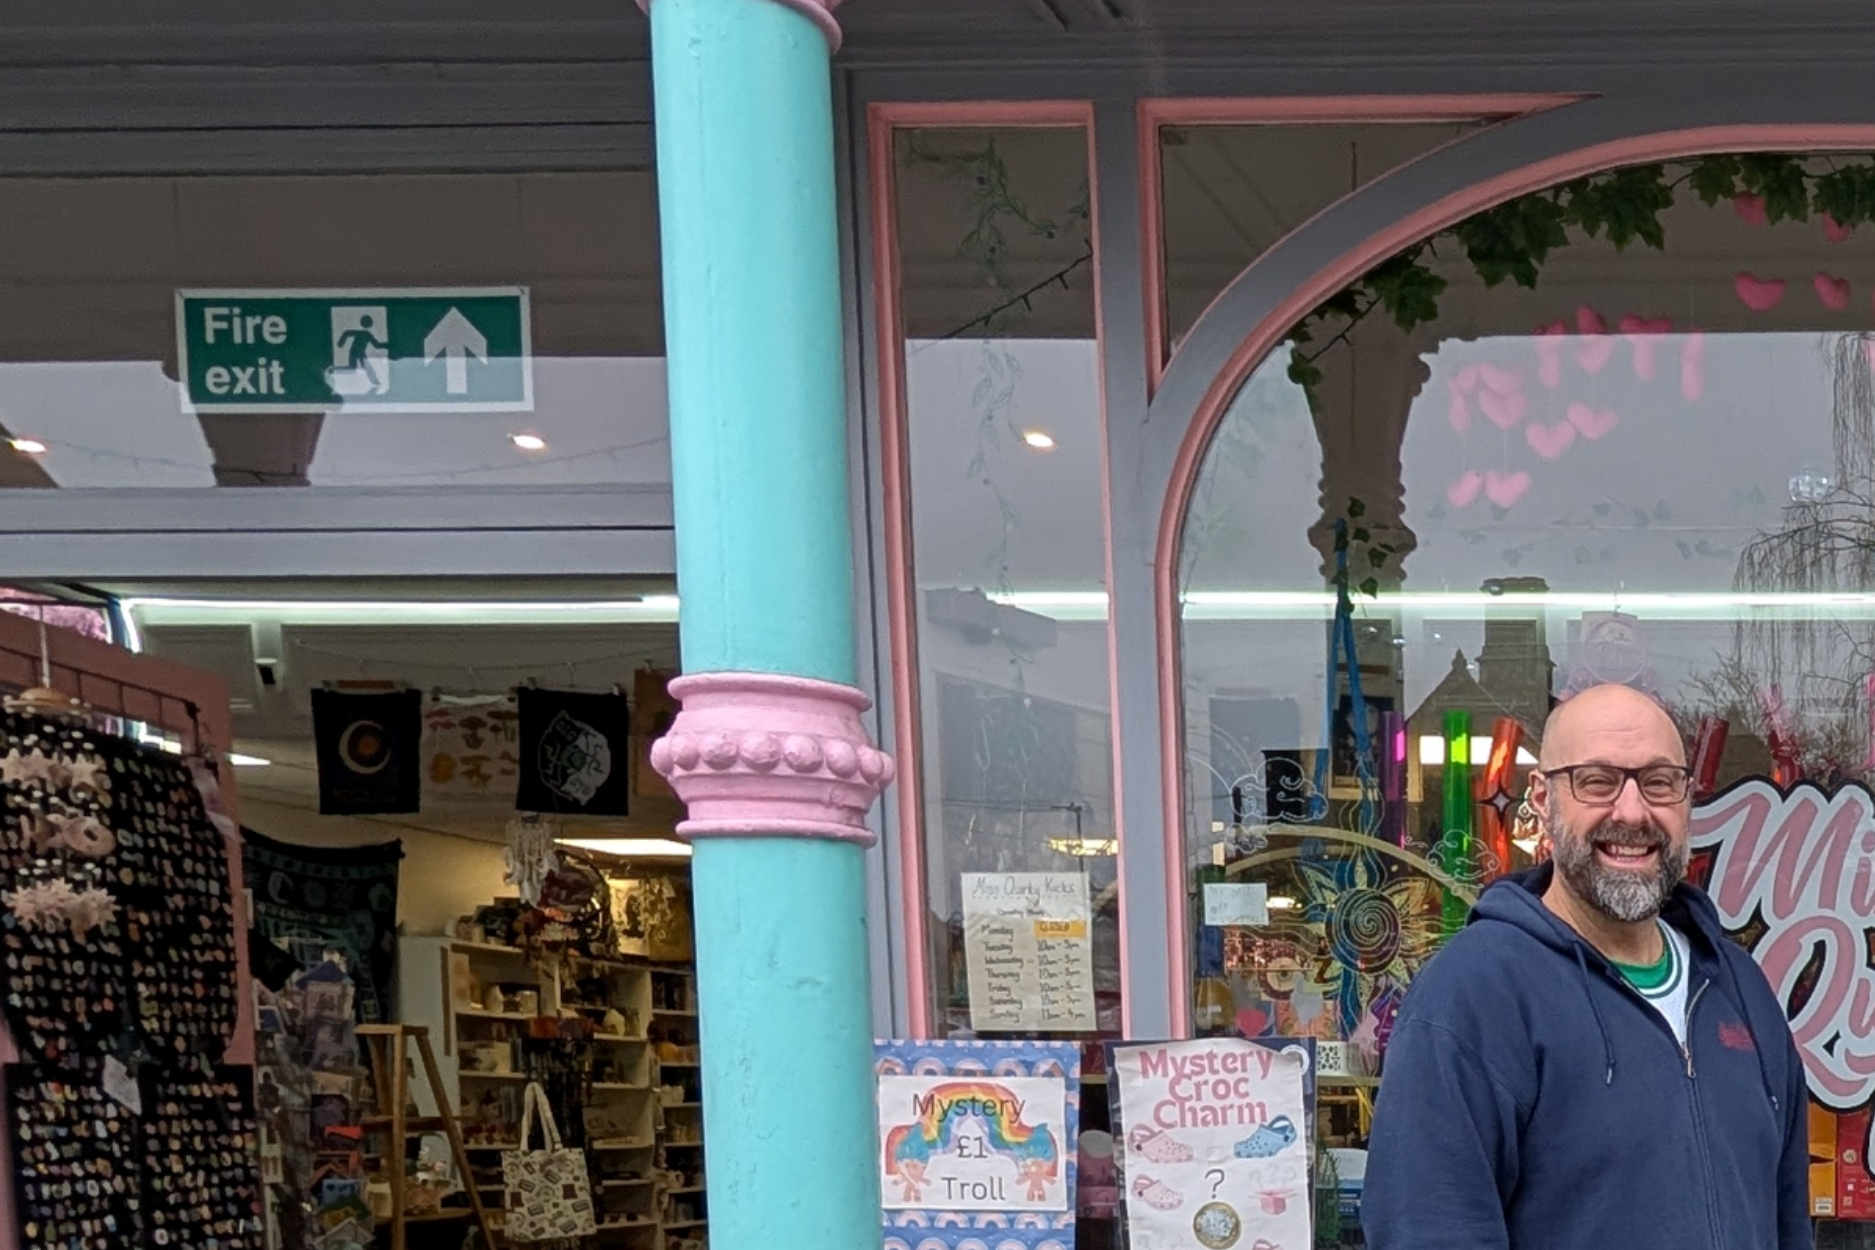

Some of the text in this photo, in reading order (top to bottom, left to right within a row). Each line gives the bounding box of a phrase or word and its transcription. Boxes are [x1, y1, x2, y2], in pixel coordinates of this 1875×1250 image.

[203, 306, 288, 346] Fire
[204, 358, 286, 396] exit
[971, 875, 1075, 908] Miss Quirky Kicks
[981, 924, 1014, 942] Monday
[983, 941, 1014, 955] Tuesday
[984, 956, 1024, 969] Wednesday
[985, 968, 1020, 983] Thursday
[987, 982, 1012, 997] Friday
[989, 995, 1024, 1011] Saturday
[990, 1008, 1021, 1023] Sunday
[1138, 1049, 1273, 1086] Mystery
[1168, 1073, 1250, 1101] Croc
[912, 1093, 1026, 1123] Mystery
[1153, 1098, 1268, 1129] Charm
[956, 1135, 989, 1159] £1
[940, 1175, 1006, 1201] Troll
[1203, 1167, 1226, 1199] ?
